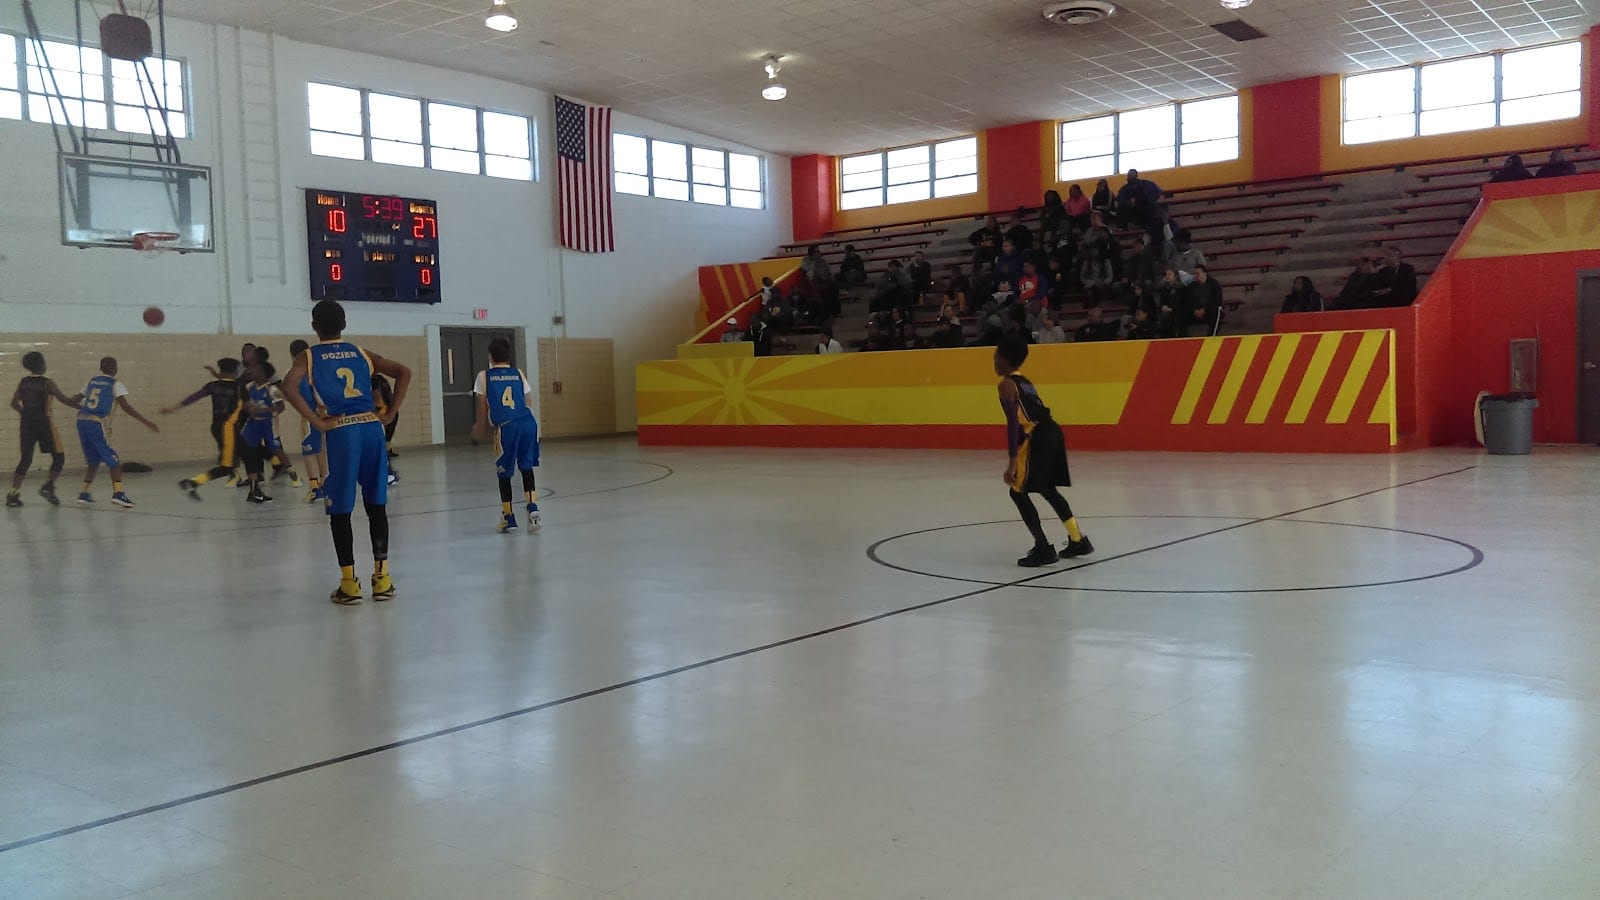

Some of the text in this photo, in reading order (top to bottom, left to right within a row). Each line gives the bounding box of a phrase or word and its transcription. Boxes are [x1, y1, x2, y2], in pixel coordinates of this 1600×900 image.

[363, 196, 404, 220] 5:39
[328, 209, 346, 233] 10
[413, 217, 437, 239] 27
[331, 264, 342, 281] 0
[421, 269, 431, 285] 0
[321, 351, 358, 360] DOZIER
[336, 367, 363, 399] 2
[86, 388, 101, 409] 5
[501, 386, 515, 410] 4
